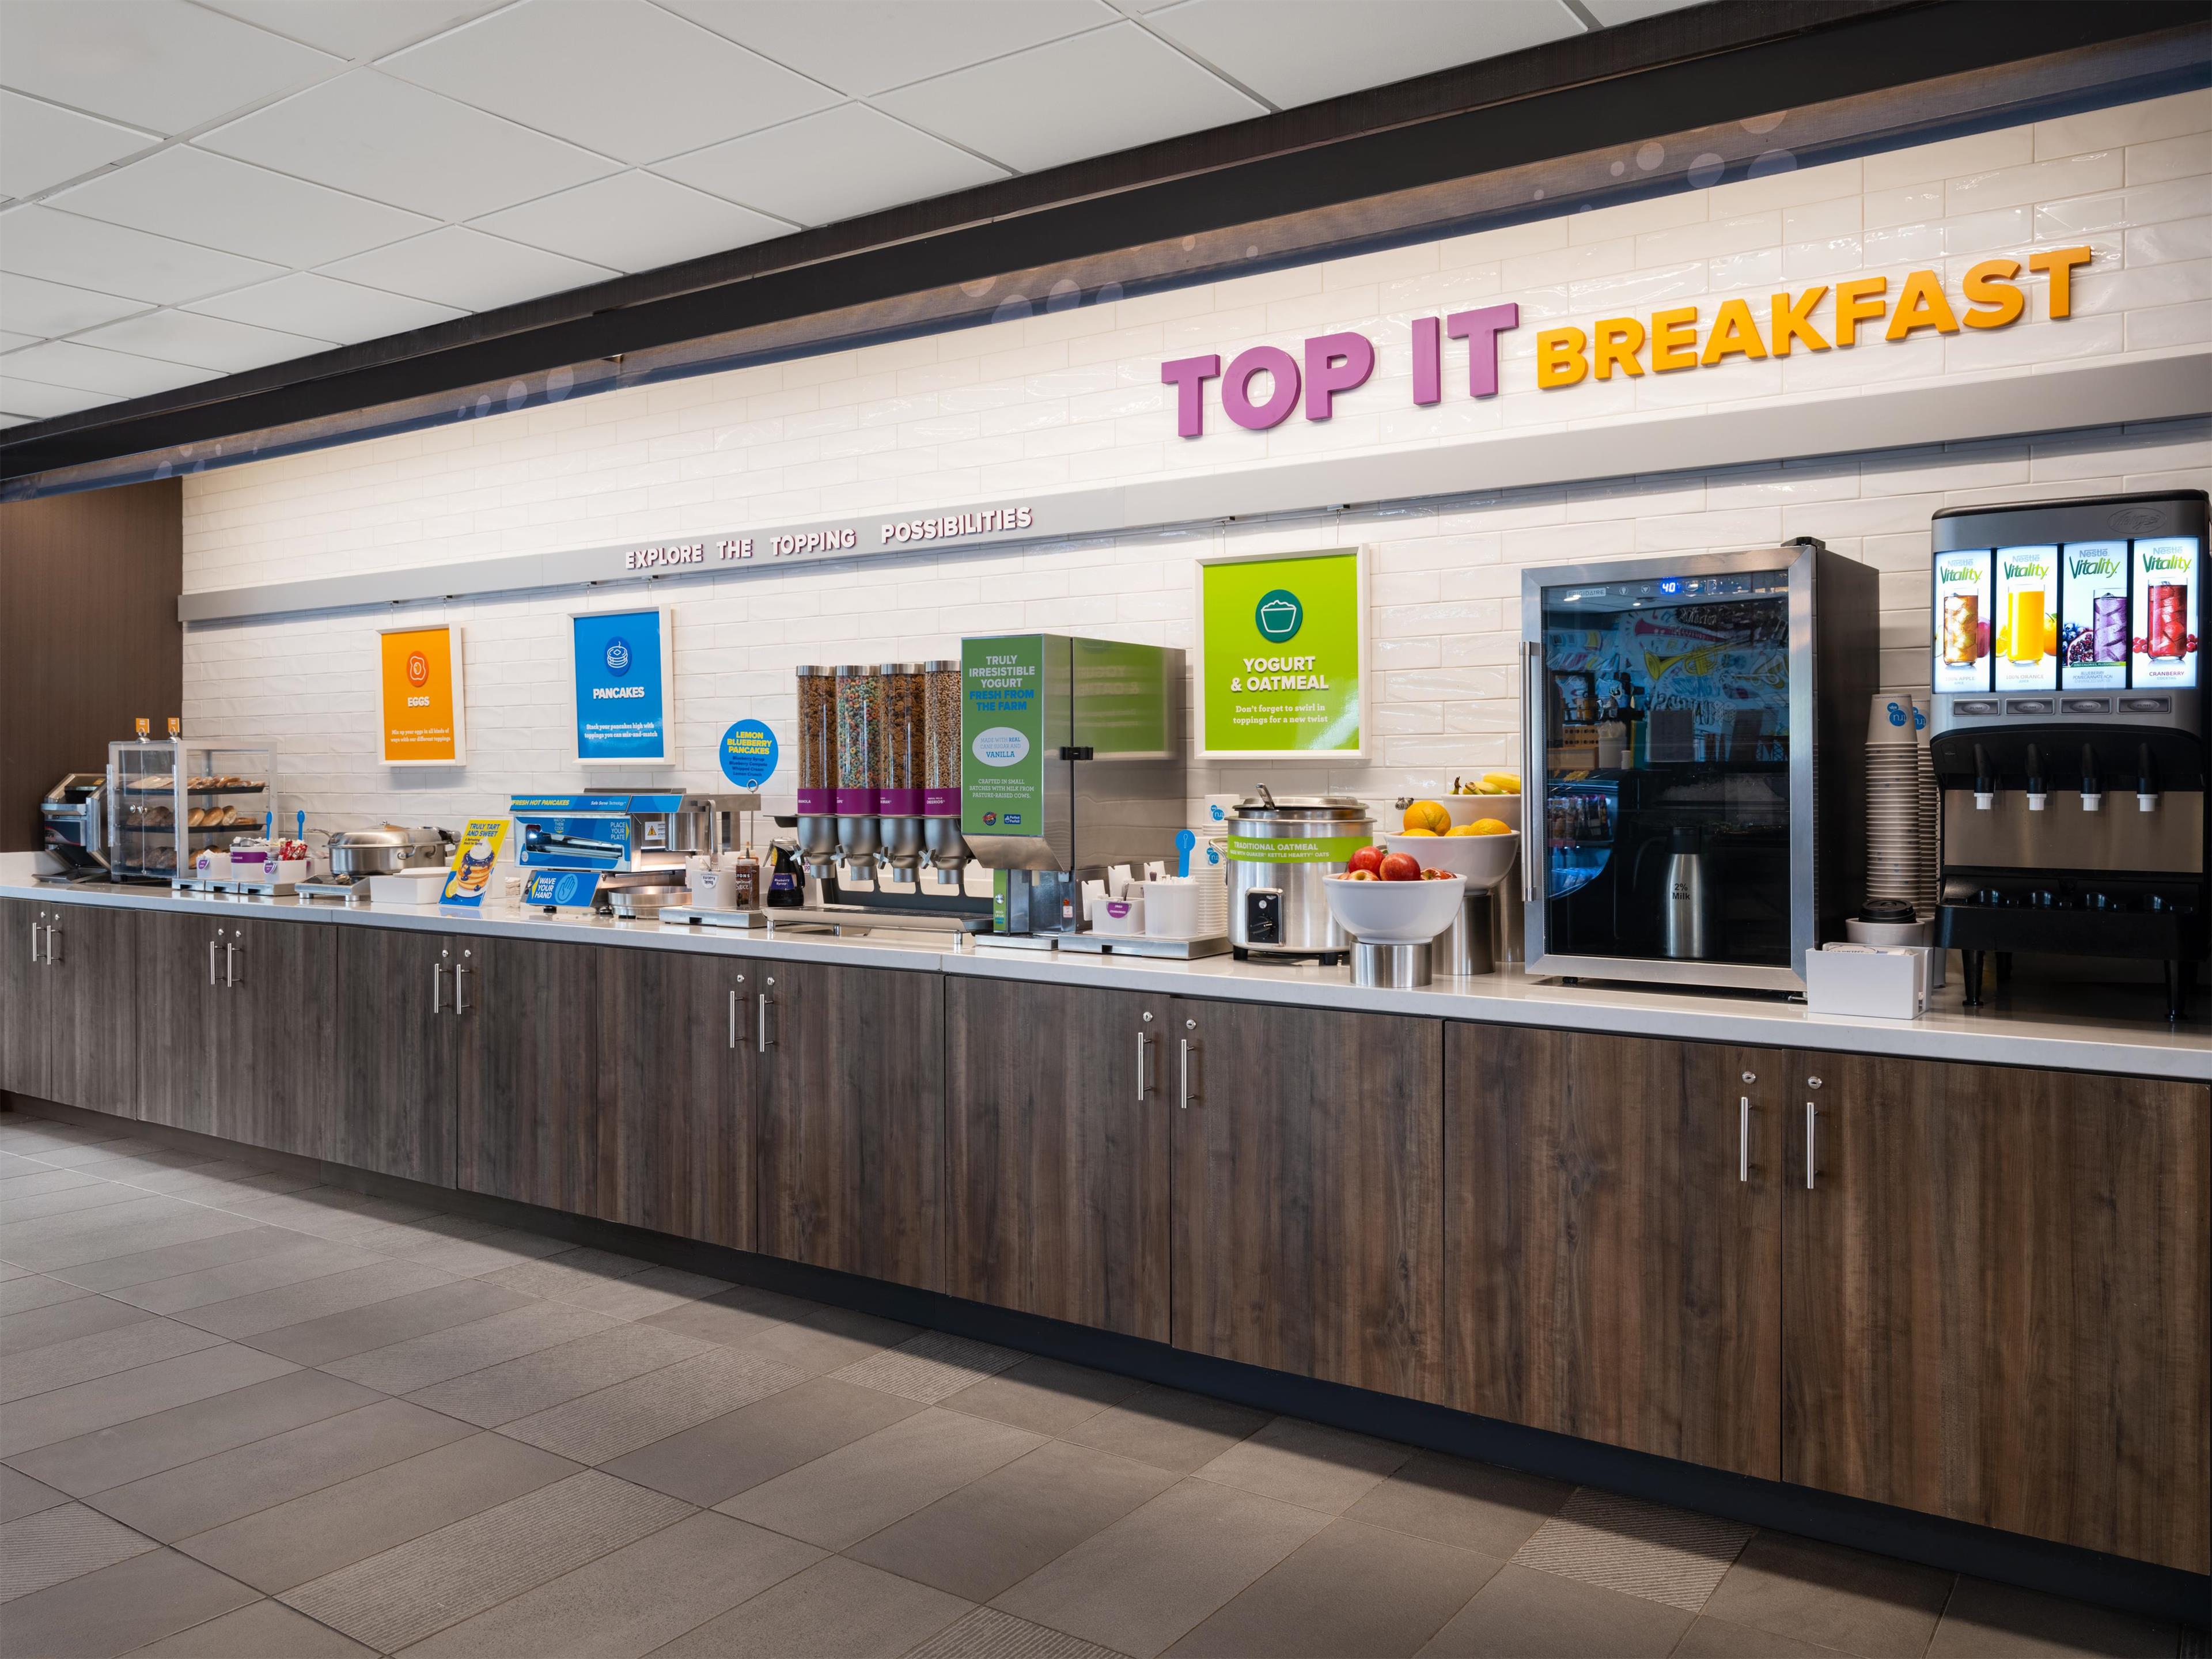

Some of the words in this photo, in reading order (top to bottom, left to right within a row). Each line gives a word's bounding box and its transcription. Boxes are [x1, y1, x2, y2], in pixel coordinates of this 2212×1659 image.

[1161, 331, 1376, 438] TOP
[1412, 302, 1520, 406] IT
[1536, 245, 2092, 390] BREAKFAST
[625, 544, 703, 569] EXPLORE
[717, 539, 753, 560] THE
[770, 528, 856, 555] TOPPING
[881, 506, 1033, 544] POSSIBILITIES
[2079, 548, 2108, 558] Nestlé
[2069, 556, 2120, 579] Vitality
[2142, 553, 2192, 573] Vitality
[1940, 566, 1983, 584] Vitality
[2004, 561, 2050, 580] Vitality
[1662, 582, 1676, 592] 40
[1568, 589, 1605, 598] FRIGIDAIRE
[986, 655, 1018, 665] TRULY
[1243, 656, 1316, 673] YOGURT
[969, 666, 1035, 677] IRRESISTIBLE
[980, 678, 1022, 688] YOGURT
[1230, 677, 1242, 692] &
[1247, 675, 1330, 691] OATMEAL
[593, 687, 645, 699] PANCAKES
[969, 691, 1002, 700] FRESH
[1004, 690, 1035, 699] FROM
[407, 696, 430, 707] EGGS
[976, 702, 996, 711] THE
[998, 700, 1027, 710] FARM
[1258, 704, 1283, 713] forget
[1295, 703, 1316, 711] swirl
[1233, 716, 1268, 725] toppings
[1269, 715, 1282, 724] for
[611, 722, 632, 730] pancakes
[632, 722, 643, 730] high
[736, 731, 764, 739] LEMON
[727, 738, 772, 747] BLUEBERRY
[728, 746, 770, 755] PANCAKES
[1233, 841, 1275, 851] TRADITIONAL
[1675, 883, 1688, 891] 2%
